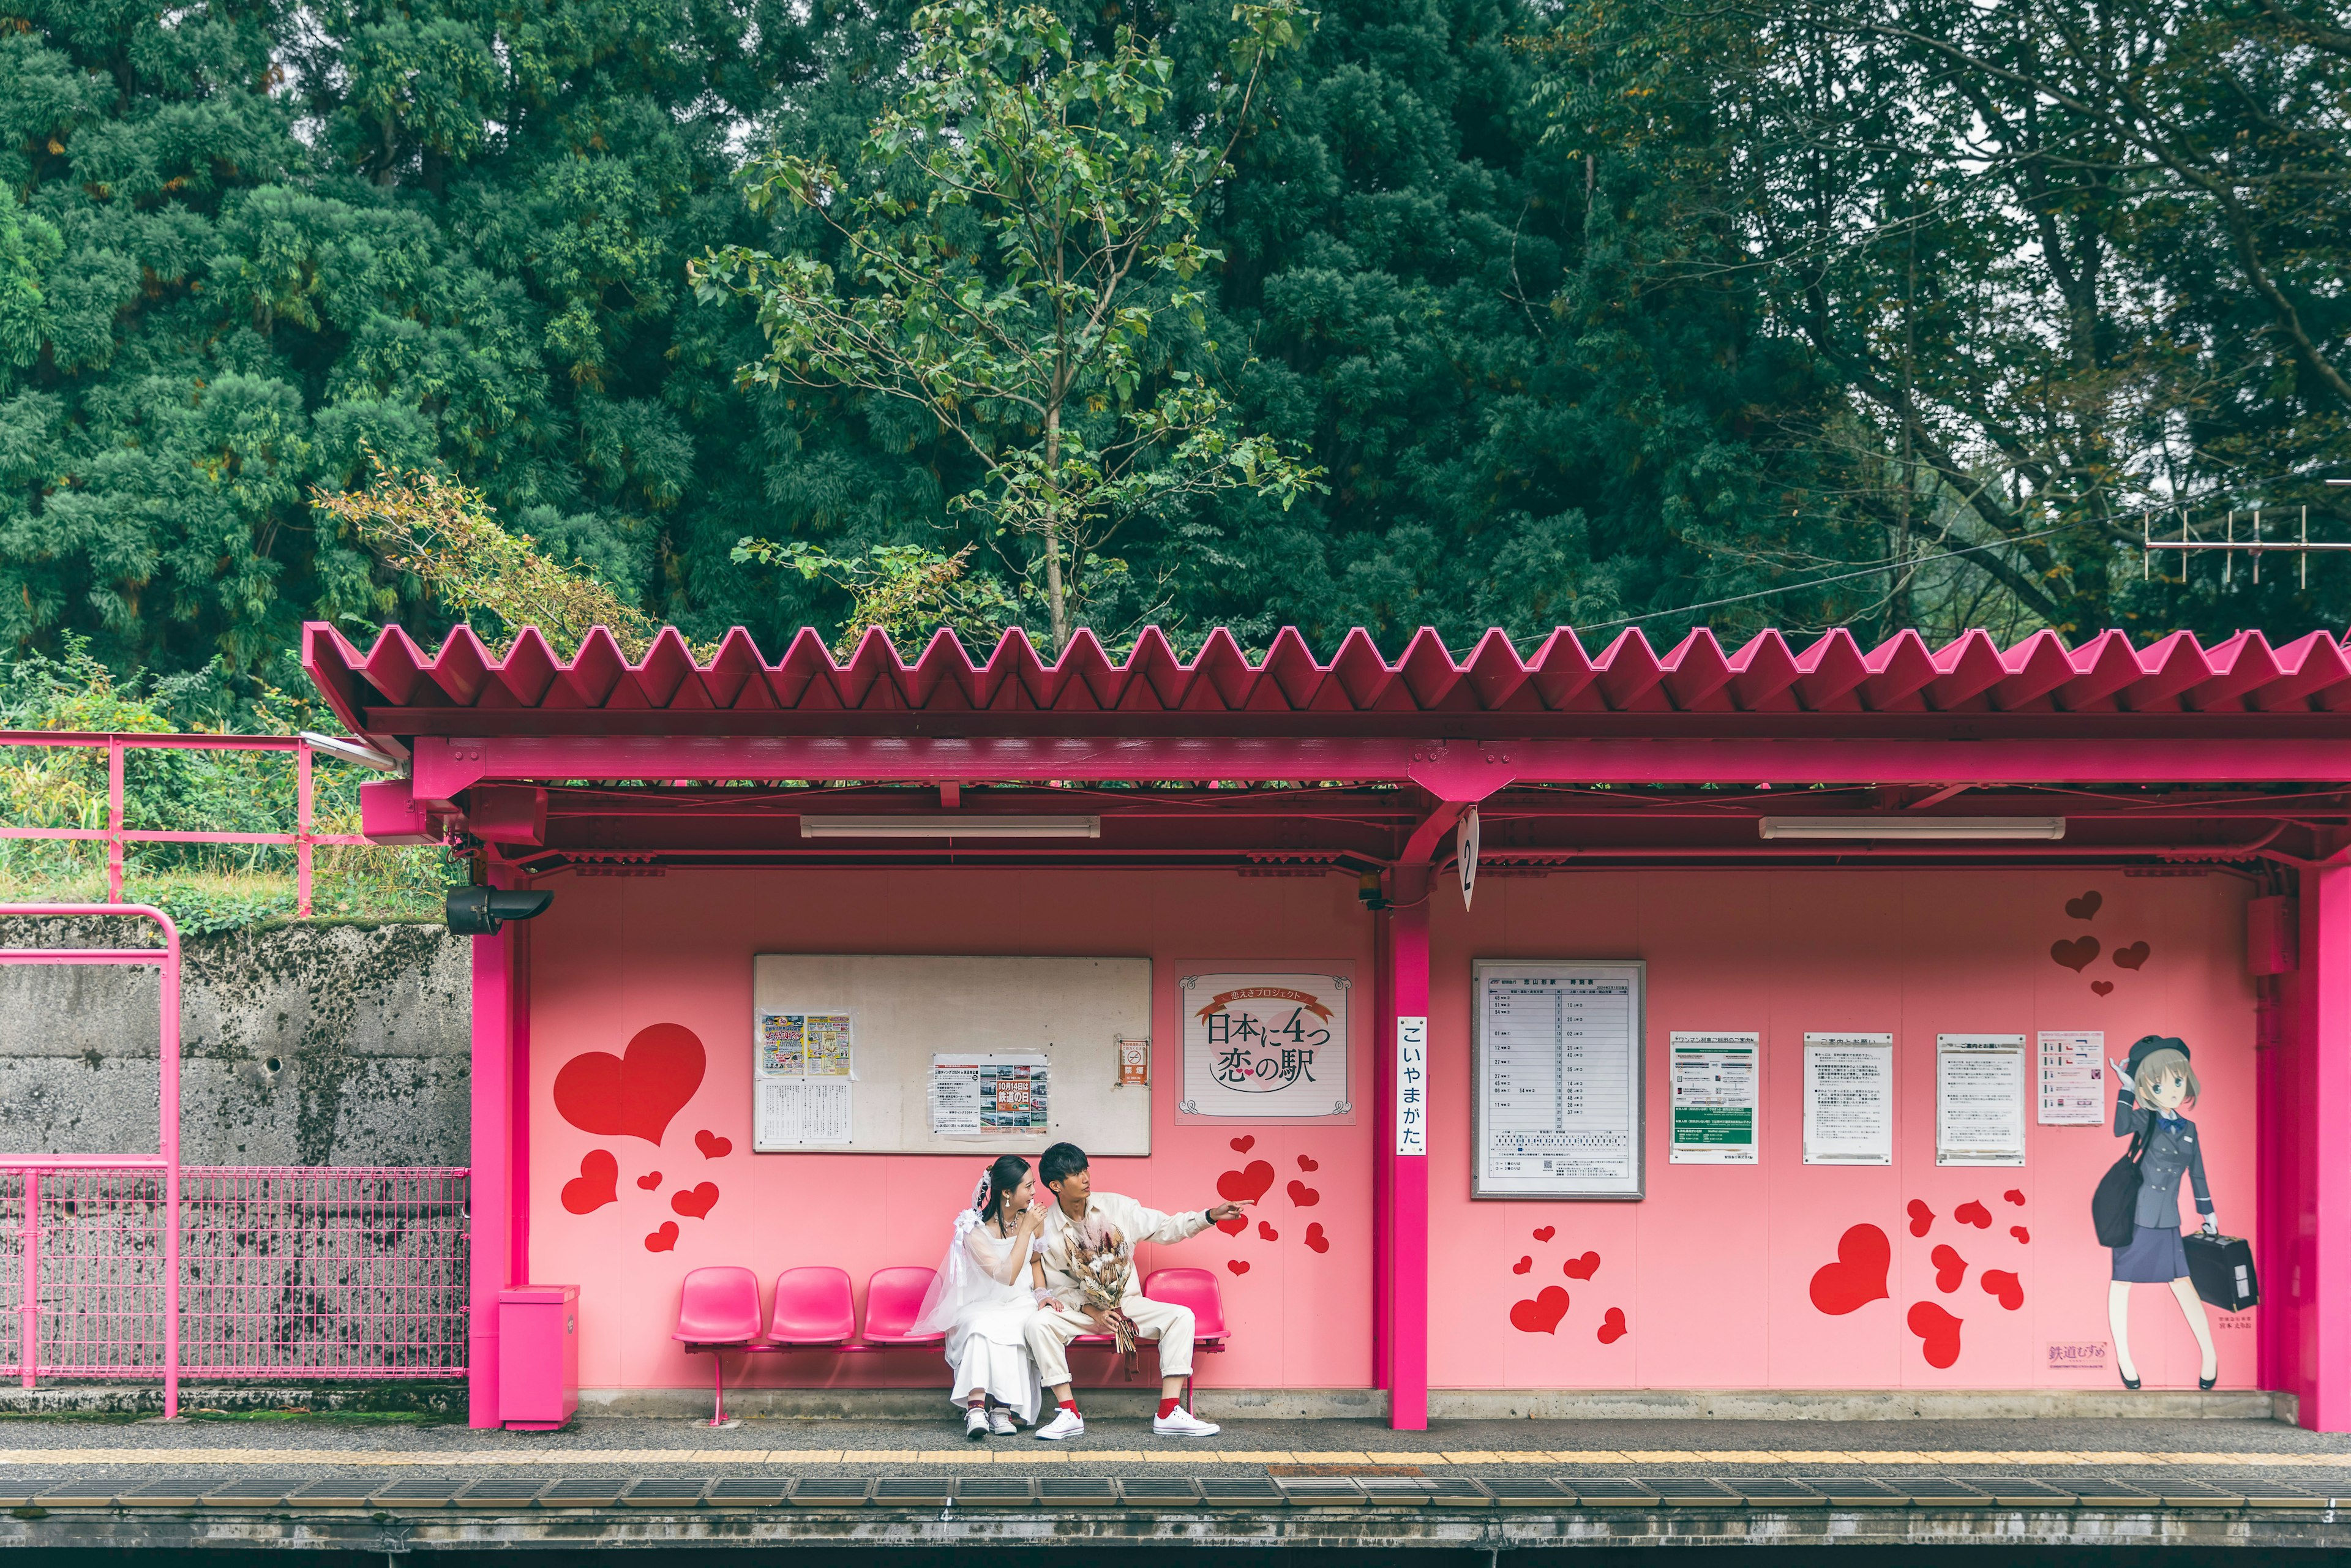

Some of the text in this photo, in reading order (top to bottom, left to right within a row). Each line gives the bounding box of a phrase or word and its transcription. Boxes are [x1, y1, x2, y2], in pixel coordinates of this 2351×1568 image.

[1464, 839, 1471, 891] 2
[1231, 988, 1300, 1000] 恋えきプロジェクト
[1208, 1007, 1330, 1048] 日本に4つ
[1217, 1048, 1316, 1082] 恋の駅
[998, 1082, 1029, 1090] 10月14日は
[1403, 1028, 1420, 1144] こいやまがた
[998, 1091, 1029, 1103] 鉄道の日
[2049, 1345, 2105, 1363] 鉄道むすめ
[2322, 1510, 2333, 1523] 3
